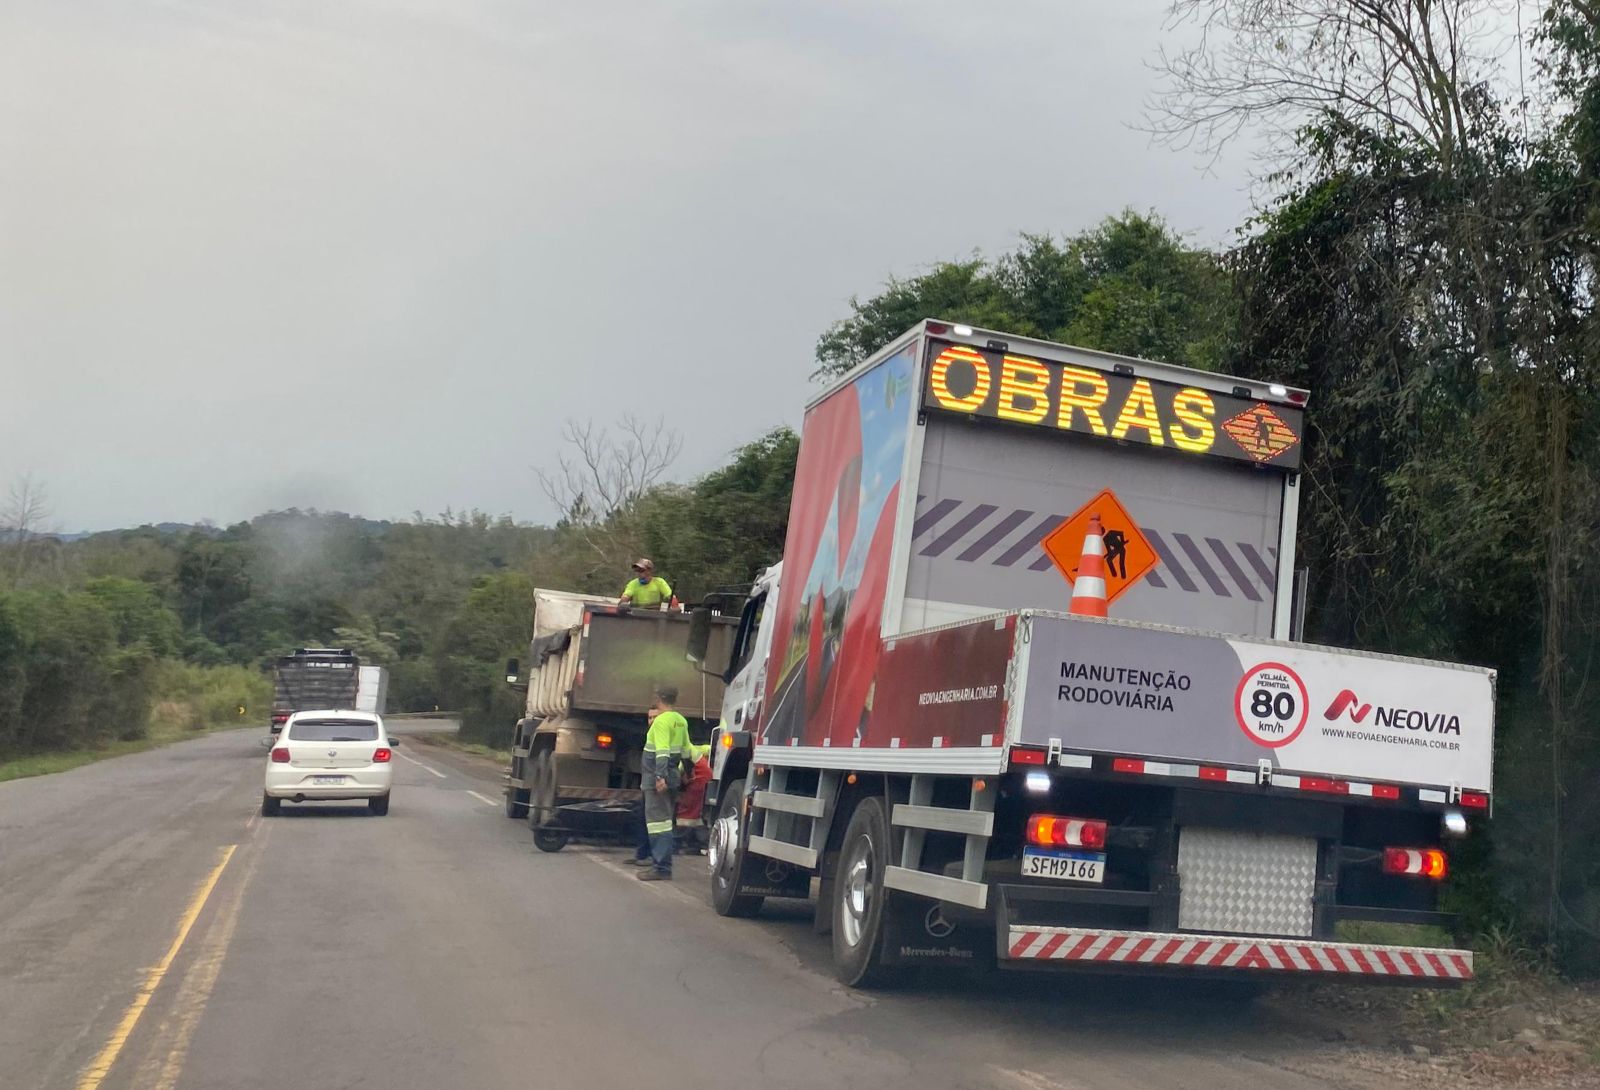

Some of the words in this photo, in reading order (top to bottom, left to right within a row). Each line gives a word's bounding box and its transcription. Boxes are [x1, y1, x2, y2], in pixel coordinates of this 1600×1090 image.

[931, 345, 1216, 452] OBRAS
[1060, 661, 1191, 691] MANUTENÇÃO
[1257, 680, 1290, 689] PERMITIDA
[1057, 685, 1174, 712] RODOVIÁRIA
[1251, 689, 1295, 720] 80
[1258, 720, 1284, 733] km/h
[1374, 706, 1461, 735] NEOVIA
[1321, 727, 1461, 751] WWW.NEOVIAENGENHARIA.COM.BR
